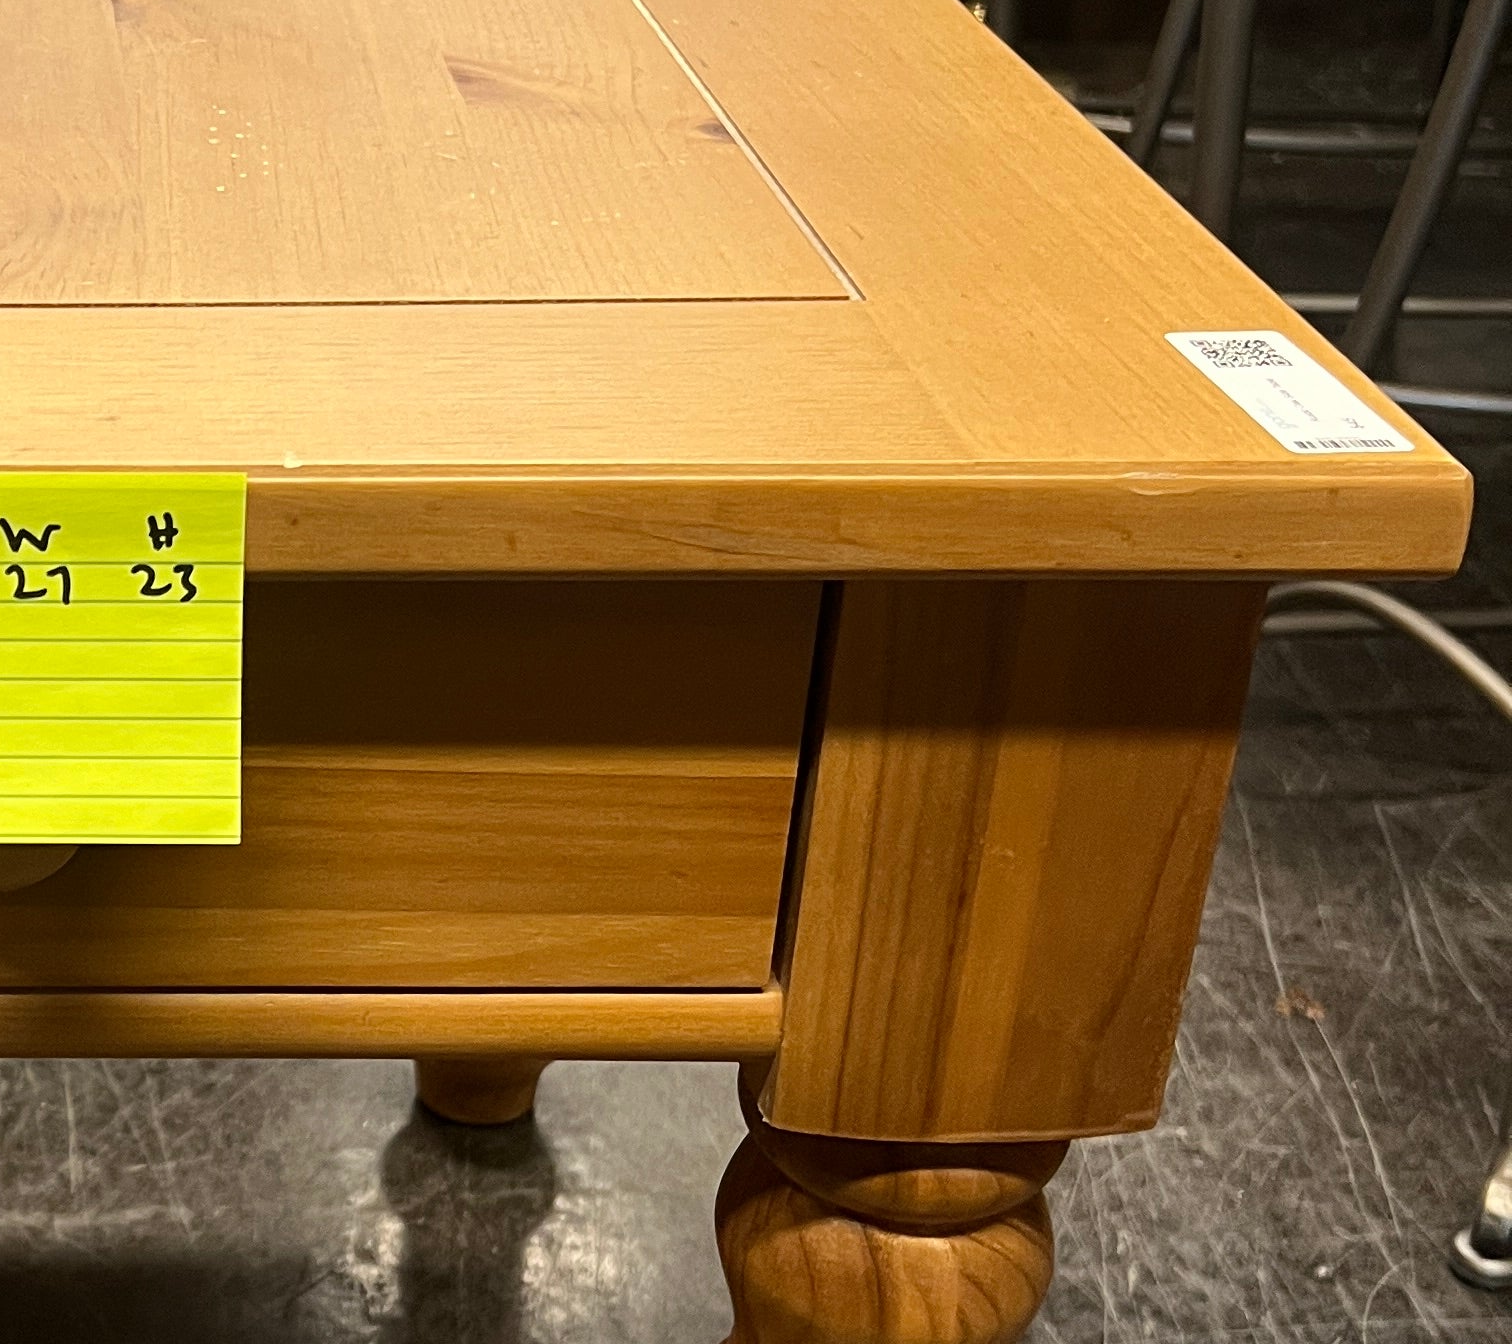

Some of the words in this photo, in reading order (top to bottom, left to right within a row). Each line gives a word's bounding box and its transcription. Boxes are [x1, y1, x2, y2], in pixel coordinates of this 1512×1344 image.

[147, 512, 179, 551] H
[5, 564, 71, 605] 27
[131, 563, 197, 603] 23
